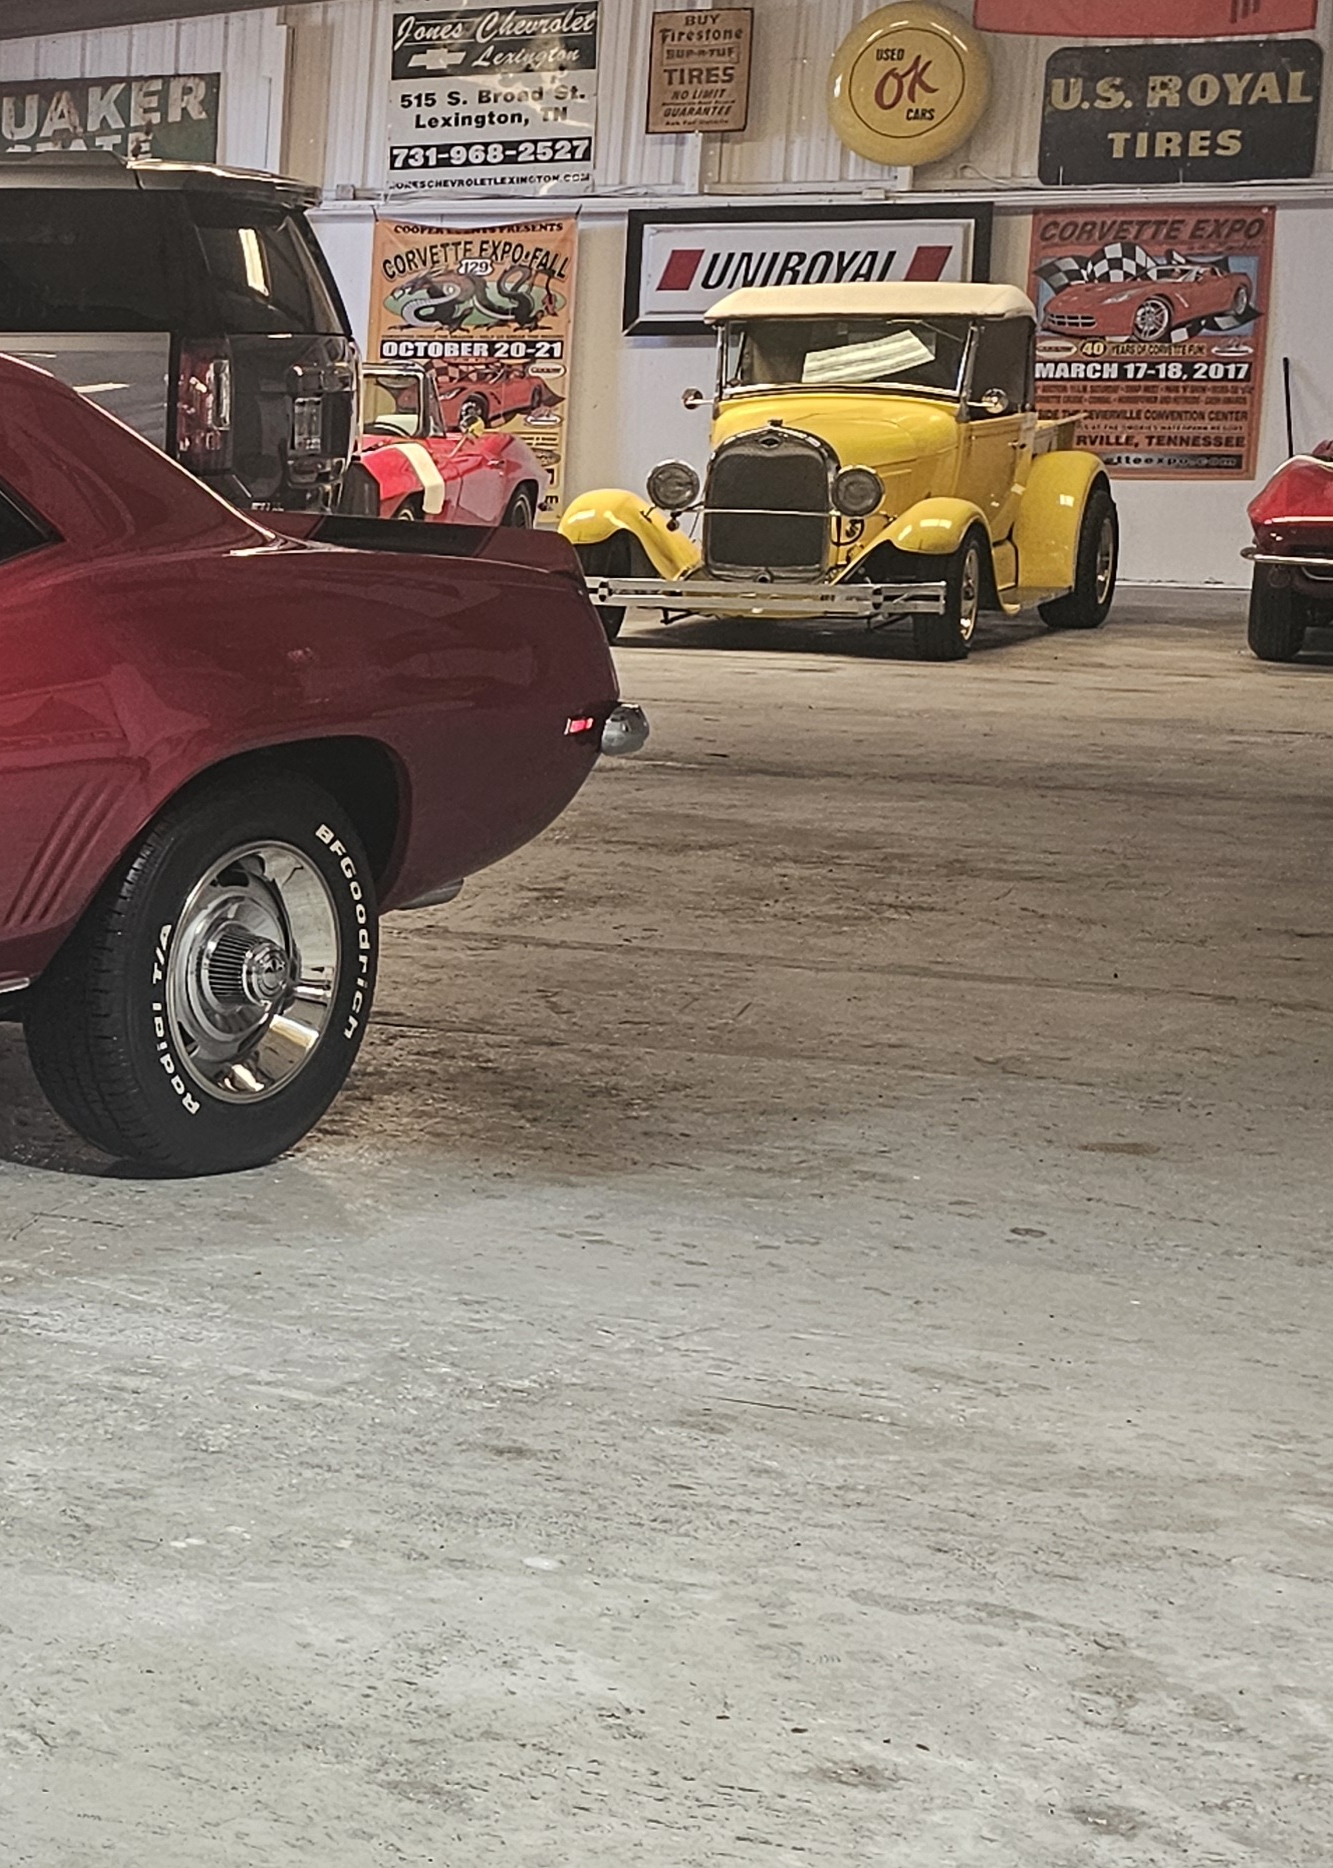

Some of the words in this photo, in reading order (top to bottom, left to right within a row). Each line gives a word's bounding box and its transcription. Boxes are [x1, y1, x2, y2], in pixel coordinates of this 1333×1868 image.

[394, 15, 463, 51] Jones
[475, 6, 597, 43] Chevrolet
[685, 14, 720, 26] BUY
[659, 28, 743, 44] Firestone
[471, 45, 581, 69] Lexington
[876, 48, 905, 61] USED
[663, 66, 735, 86] TIRES
[874, 54, 940, 110] OK
[401, 92, 437, 109] 515
[447, 91, 468, 106] S.
[478, 86, 544, 104] Broad
[554, 85, 586, 100] St.
[671, 90, 690, 100] NO
[692, 88, 727, 99] LIMIT
[1050, 76, 1133, 110] U.S.
[1146, 71, 1313, 108] ROYAL
[415, 111, 530, 128] Lexington,
[540, 107, 568, 122] TN
[663, 106, 732, 117] GUARANTEE
[906, 108, 935, 121] CARS
[392, 140, 590, 168] 731-968-2527
[1107, 129, 1242, 158] TIRES
[1039, 218, 1186, 241] CORVETTE
[1188, 217, 1267, 240] EXPO
[383, 240, 473, 280] CORVETTE
[464, 261, 489, 275] 129
[700, 250, 897, 290] UNIROYAL
[383, 341, 489, 357] OCTOBER
[494, 341, 562, 358] 20-21
[1082, 342, 1104, 355] 40
[1034, 363, 1118, 378] MARCH
[1124, 363, 1188, 380] 17-18,
[1193, 363, 1249, 379] 2017
[1144, 409, 1205, 421] CONVENTION
[1208, 410, 1248, 421] CENTER
[1145, 435, 1246, 448] TENNESSEE
[315, 823, 371, 1040] BFGoodrich
[151, 923, 173, 986] T/A
[151, 1002, 201, 1116] Radial
